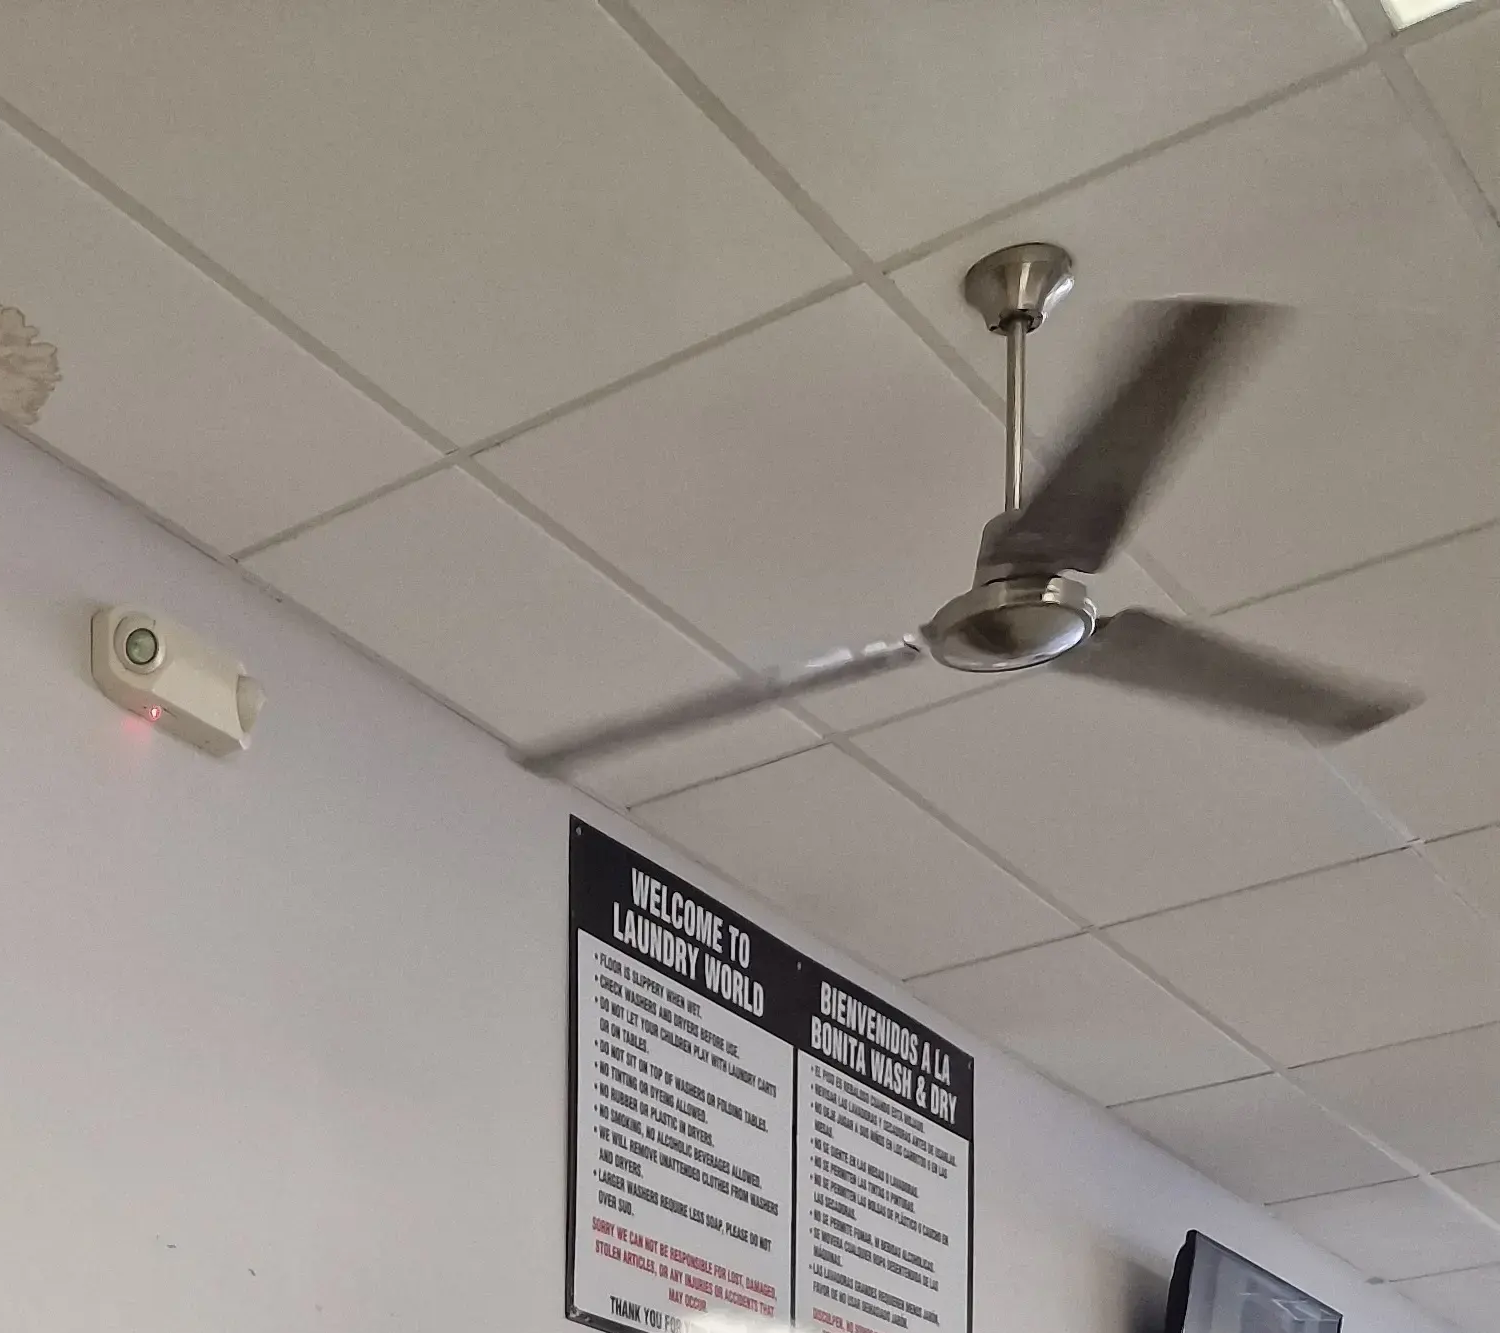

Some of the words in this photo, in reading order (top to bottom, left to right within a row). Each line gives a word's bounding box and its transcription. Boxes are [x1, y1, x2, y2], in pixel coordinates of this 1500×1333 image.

[613, 901, 699, 981] LAUNDRY
[704, 953, 764, 1018] WORLD
[631, 867, 725, 954] WELCOME
[728, 924, 750, 969] TO
[623, 966, 631, 981] IS
[811, 1015, 866, 1076] BONITA
[871, 1048, 912, 1100] WASH
[915, 1075, 927, 1109] &
[931, 1083, 957, 1124] DRY
[820, 981, 919, 1066] BIENVENIDOS
[921, 1041, 932, 1074] A
[934, 1048, 951, 1086] LA
[599, 1147, 613, 1165] AND
[599, 1125, 610, 1142] WE
[611, 1131, 628, 1150] WILL
[630, 1139, 657, 1164] REMOVE
[701, 1171, 729, 1195] CLOTHES
[731, 1184, 749, 1203] FROM
[750, 1193, 778, 1216] WASHERS
[609, 1295, 642, 1324] THANK
[643, 1307, 662, 1330] YOU
[669, 1287, 683, 1305] MAY
